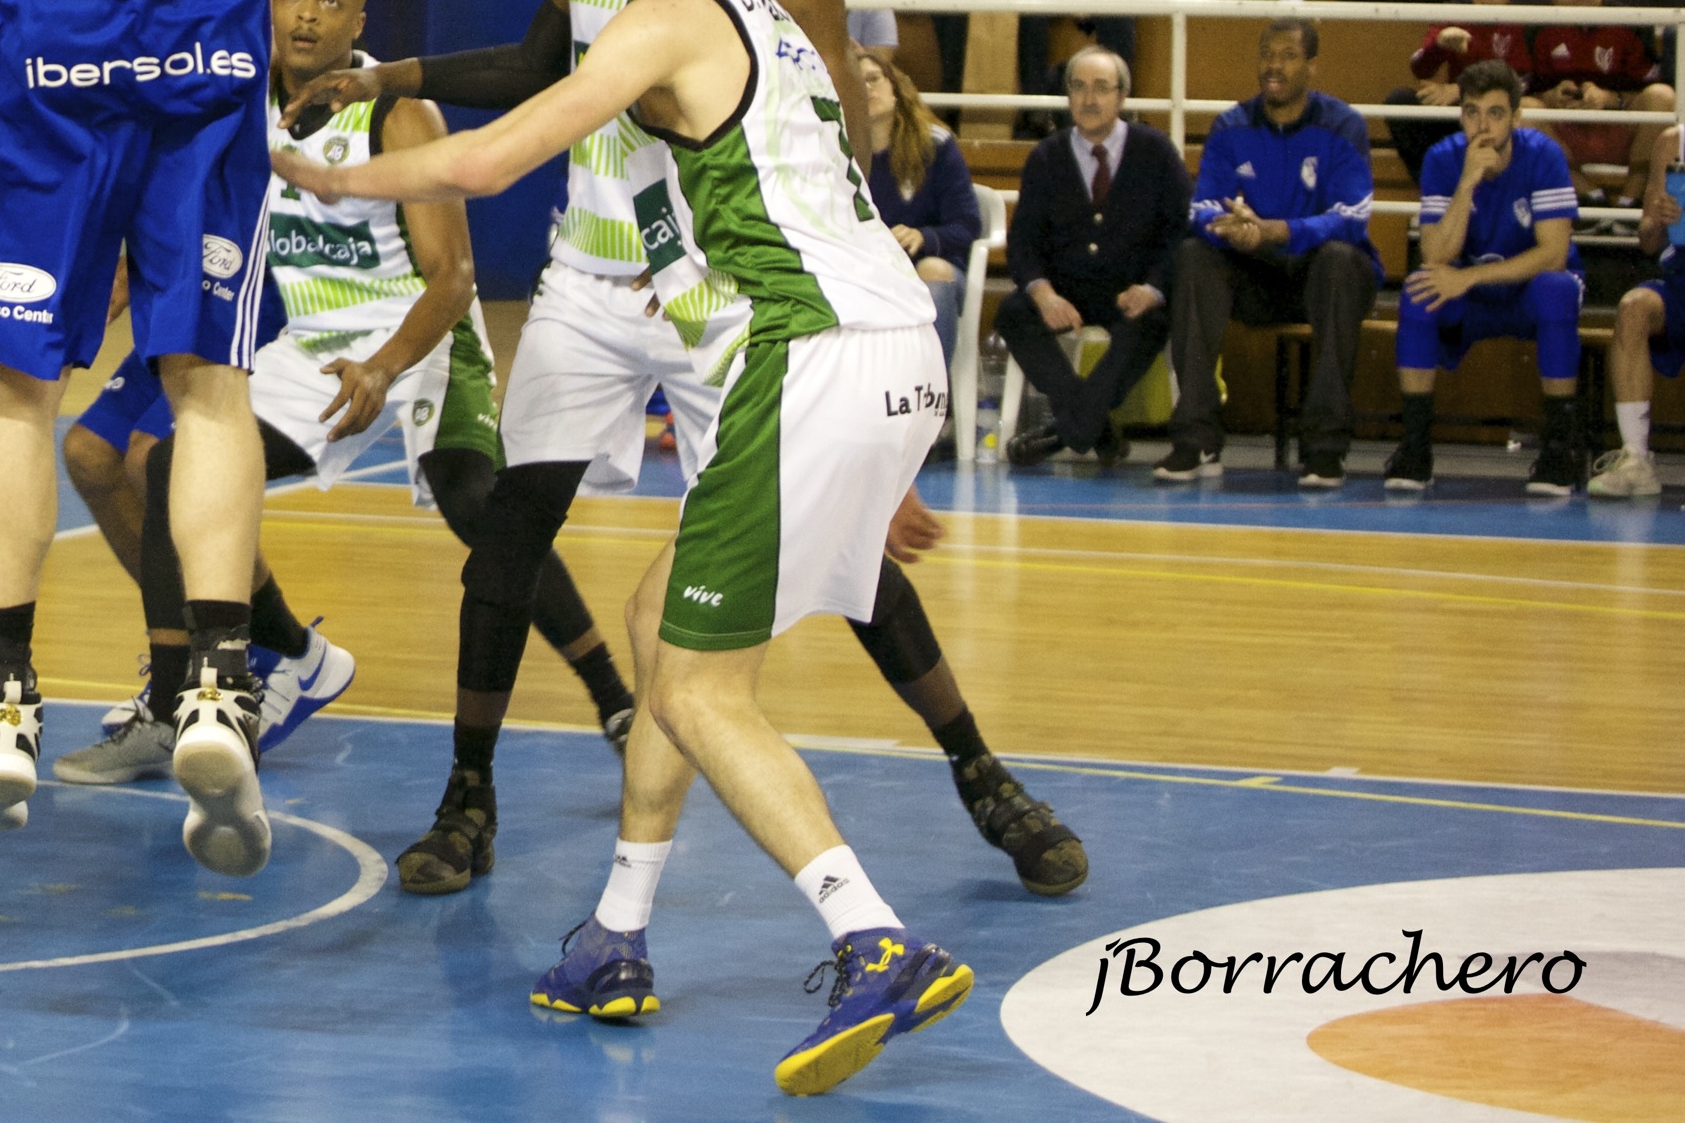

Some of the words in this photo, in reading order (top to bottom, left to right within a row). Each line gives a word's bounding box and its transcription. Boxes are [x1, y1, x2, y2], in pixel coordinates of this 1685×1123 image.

[25, 41, 256, 89] ibersol.es
[265, 228, 373, 265] lobalcaja
[885, 390, 912, 417] La
[683, 585, 724, 607] vive
